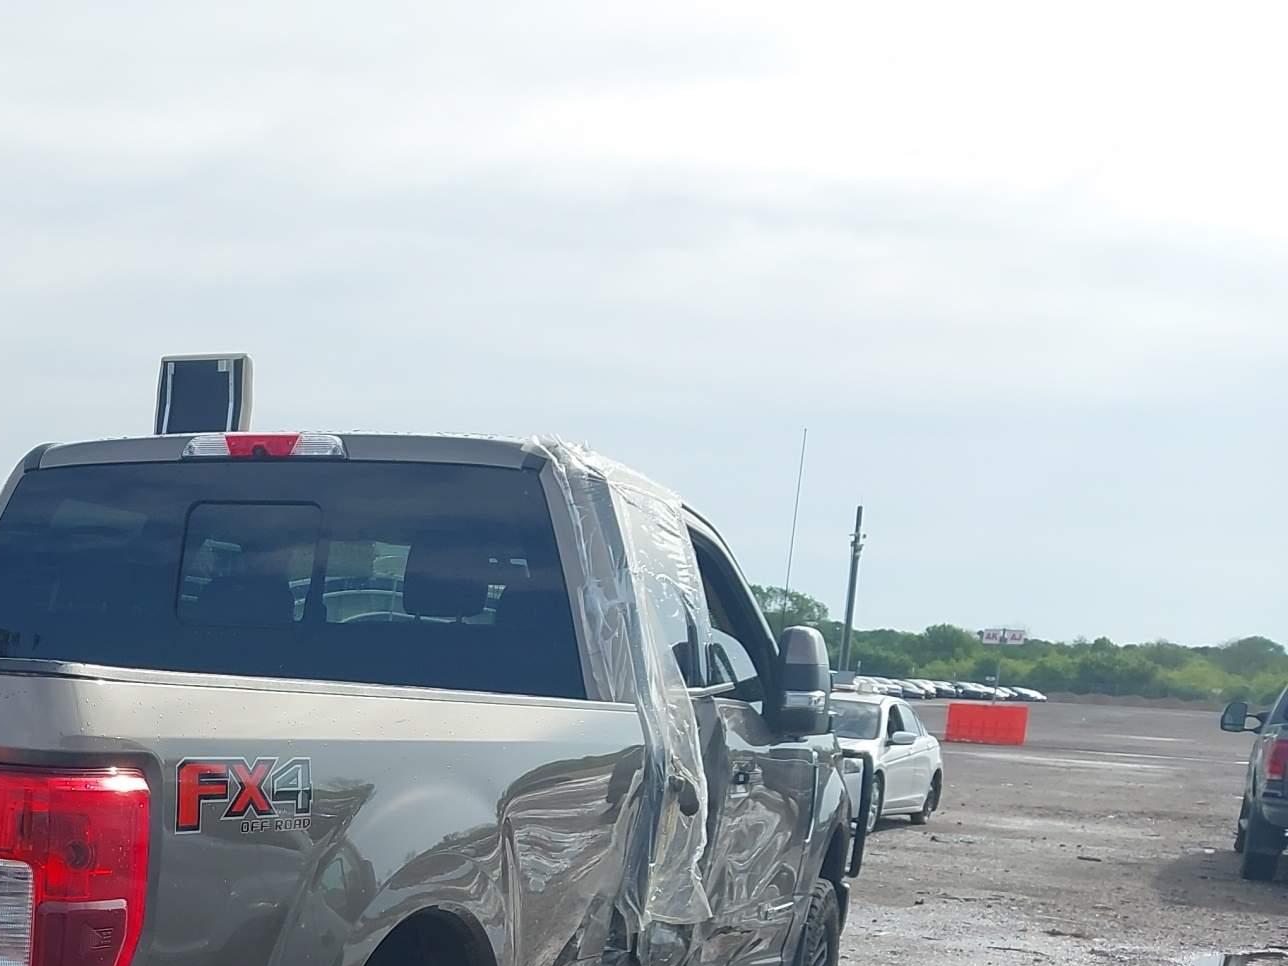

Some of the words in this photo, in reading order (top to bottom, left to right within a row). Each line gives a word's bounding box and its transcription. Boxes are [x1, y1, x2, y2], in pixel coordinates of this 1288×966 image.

[175, 757, 312, 835] FX4
[240, 818, 272, 834] OFF
[274, 817, 312, 833] ROAD
